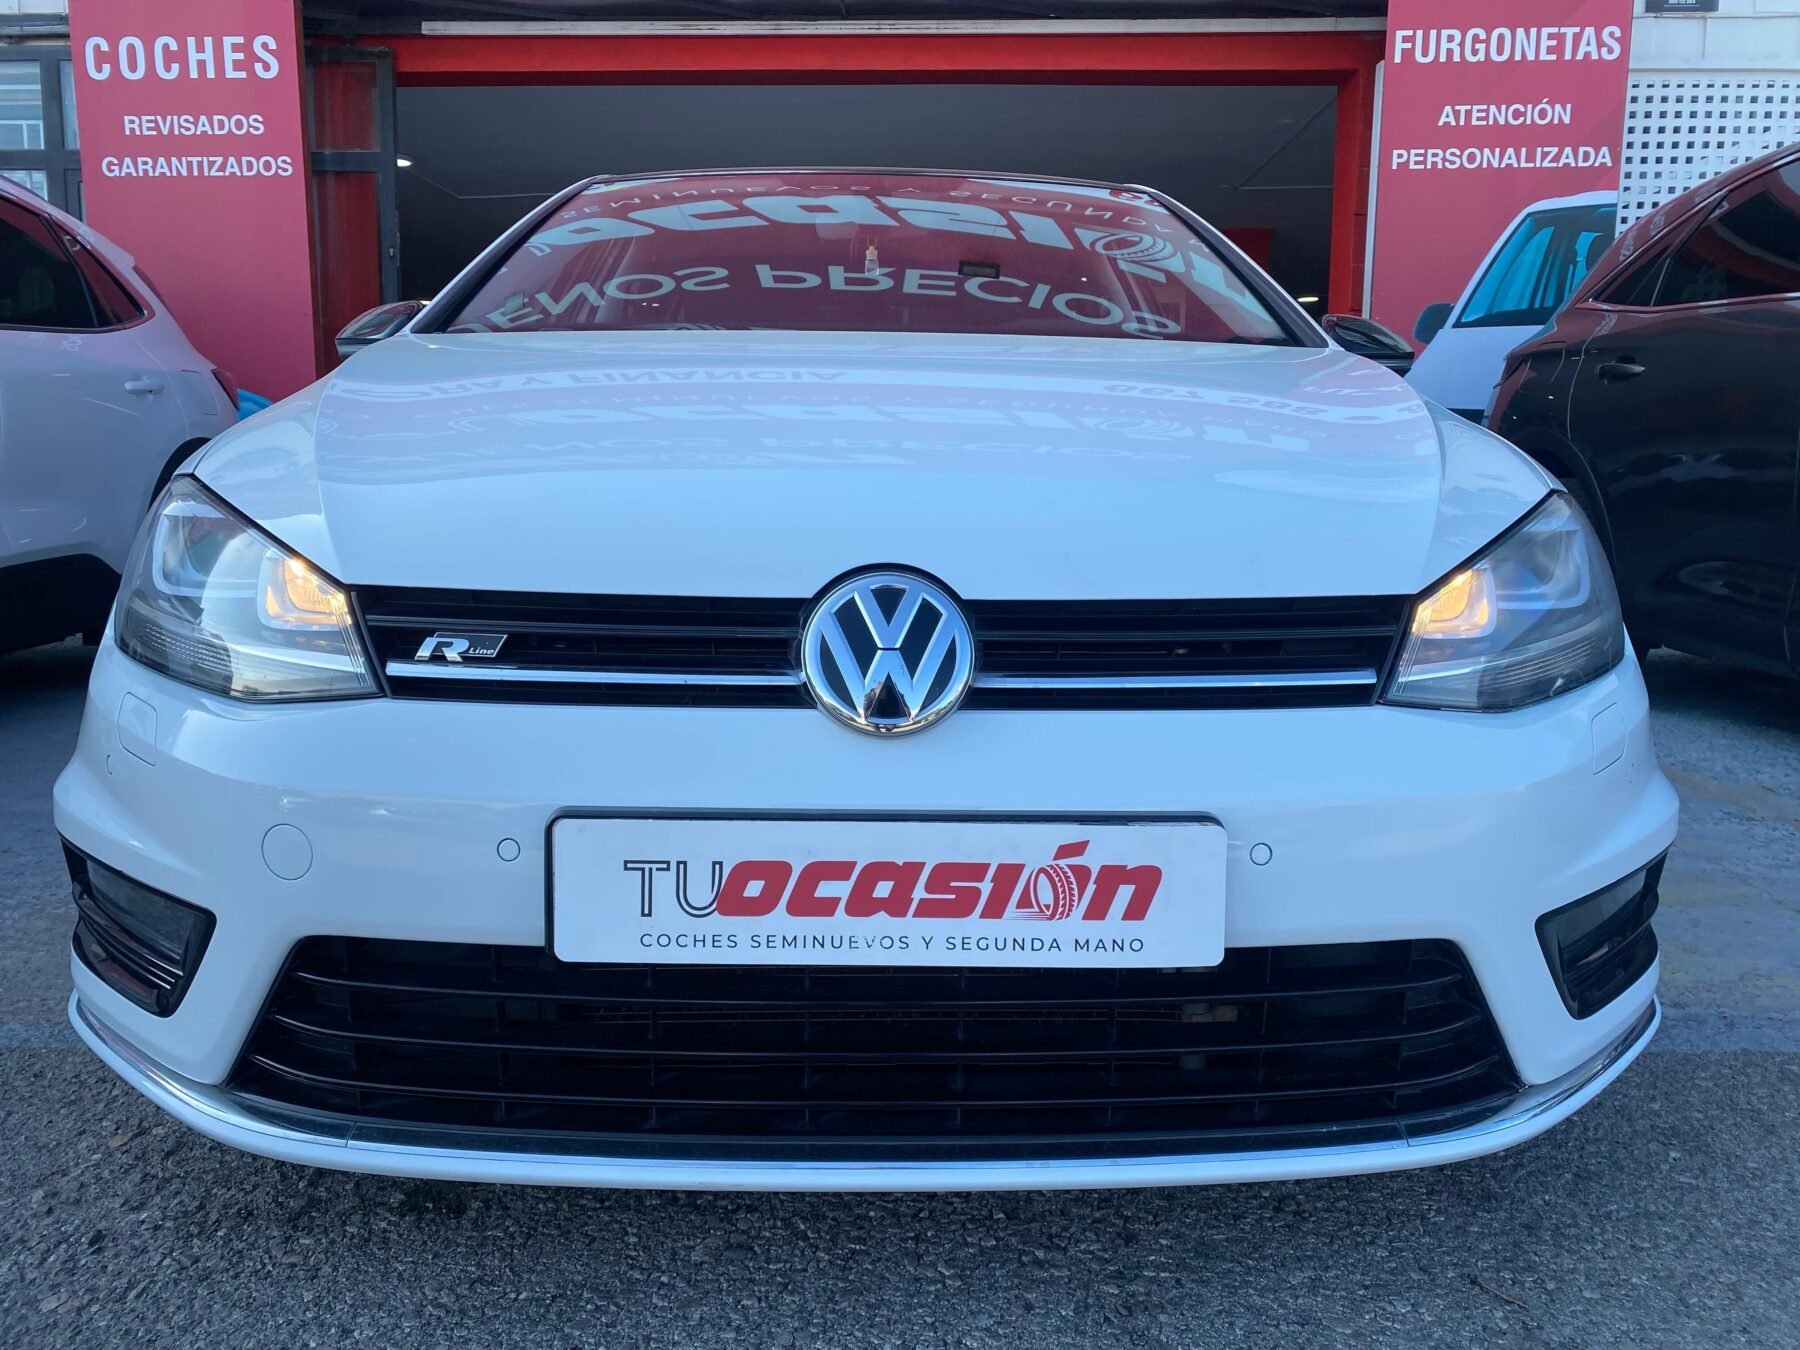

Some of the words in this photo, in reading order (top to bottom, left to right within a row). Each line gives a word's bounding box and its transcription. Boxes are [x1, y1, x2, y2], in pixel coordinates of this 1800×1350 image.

[1393, 25, 1622, 64] FURGONETAS
[85, 34, 280, 80] COCHES
[1437, 98, 1572, 126] ATENCIÓN
[123, 114, 265, 136] REVISADOS
[101, 155, 293, 177] GARANTIZADOS
[1391, 146, 1613, 170] PERSONALIZADA
[414, 637, 464, 662] R
[468, 646, 495, 655] Line
[639, 933, 738, 949] COCHES
[750, 934, 910, 950] SEMINUEVOS
[921, 936, 934, 950] Y
[945, 936, 1062, 952] SEGUNDA
[1074, 938, 1145, 953] MANO
